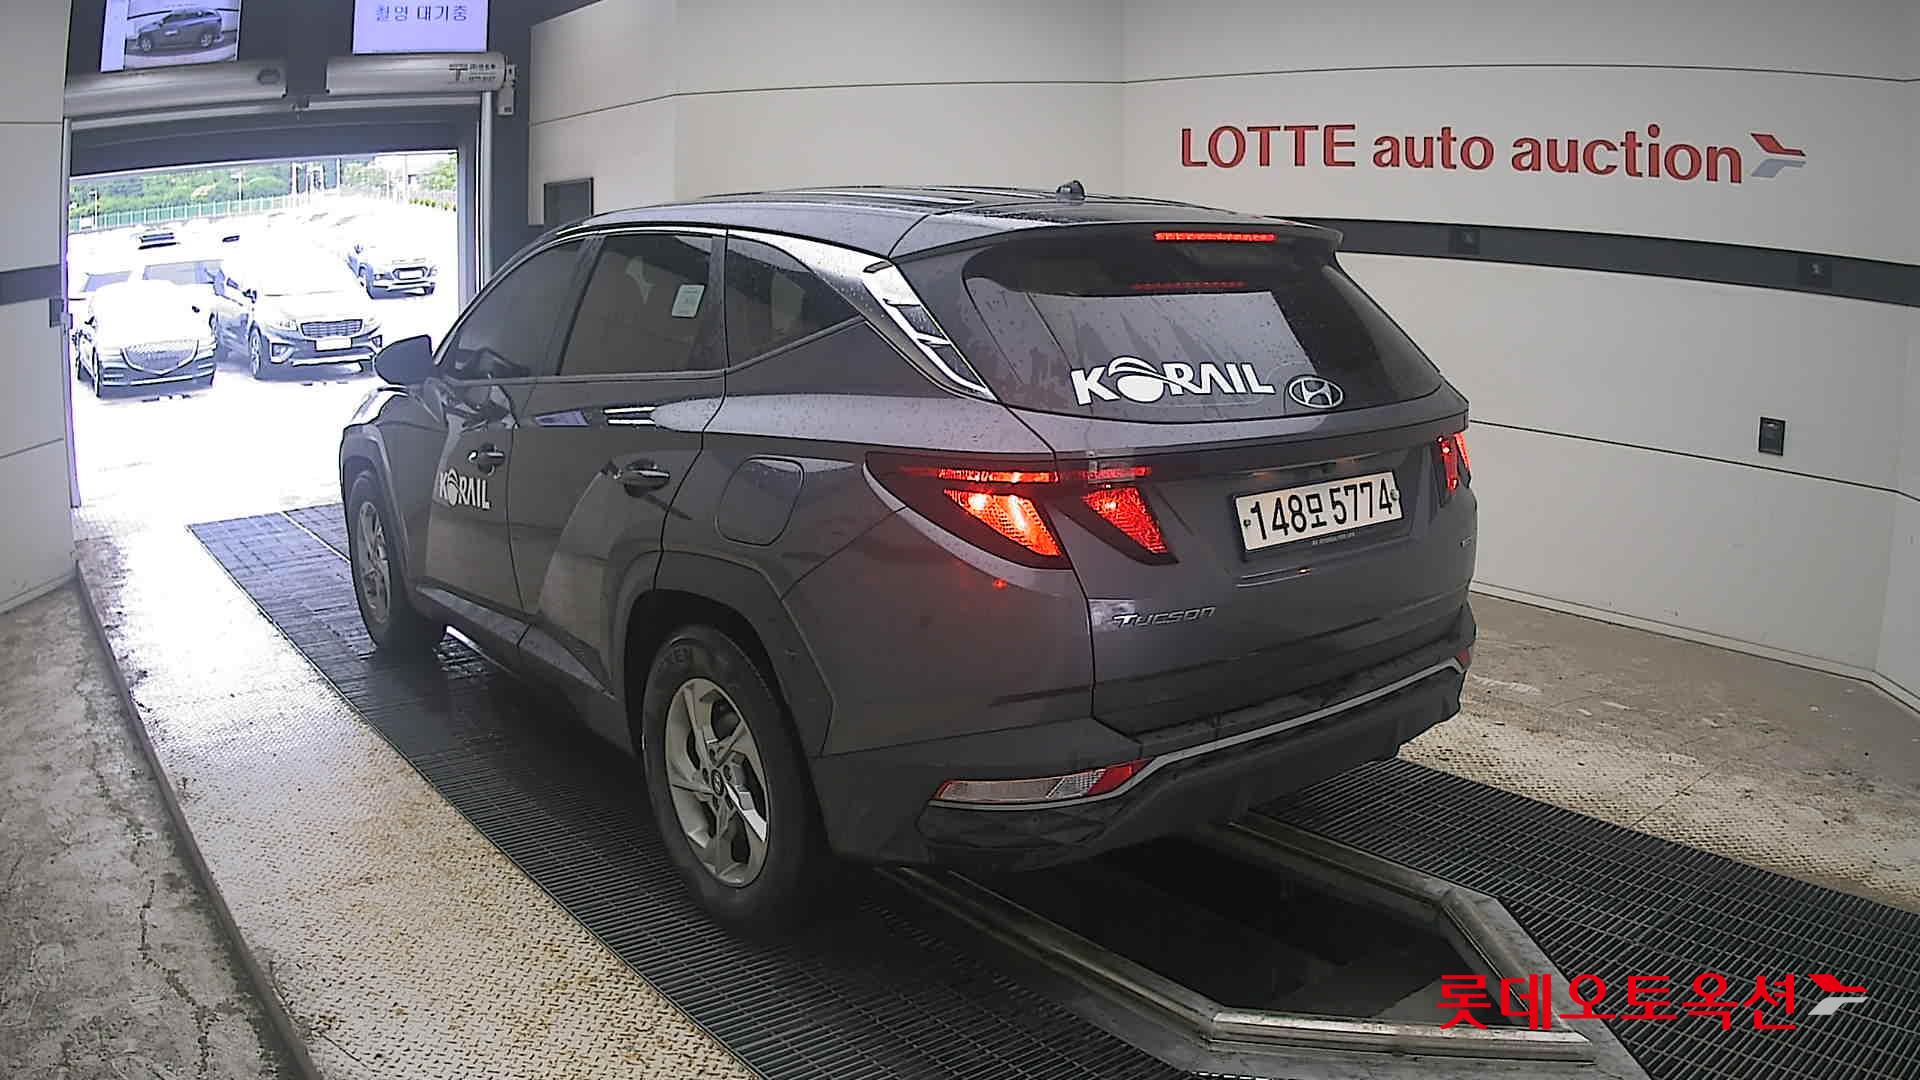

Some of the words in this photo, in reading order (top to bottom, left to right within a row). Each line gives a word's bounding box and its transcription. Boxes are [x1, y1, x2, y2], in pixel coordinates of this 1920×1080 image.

[417, 5, 467, 21] 대기중
[1181, 124, 1356, 168] LOTTE
[1372, 126, 1494, 169] auto
[1511, 124, 1743, 184] auction
[1071, 356, 1275, 405] KORAIL
[439, 467, 490, 509] KORAIL
